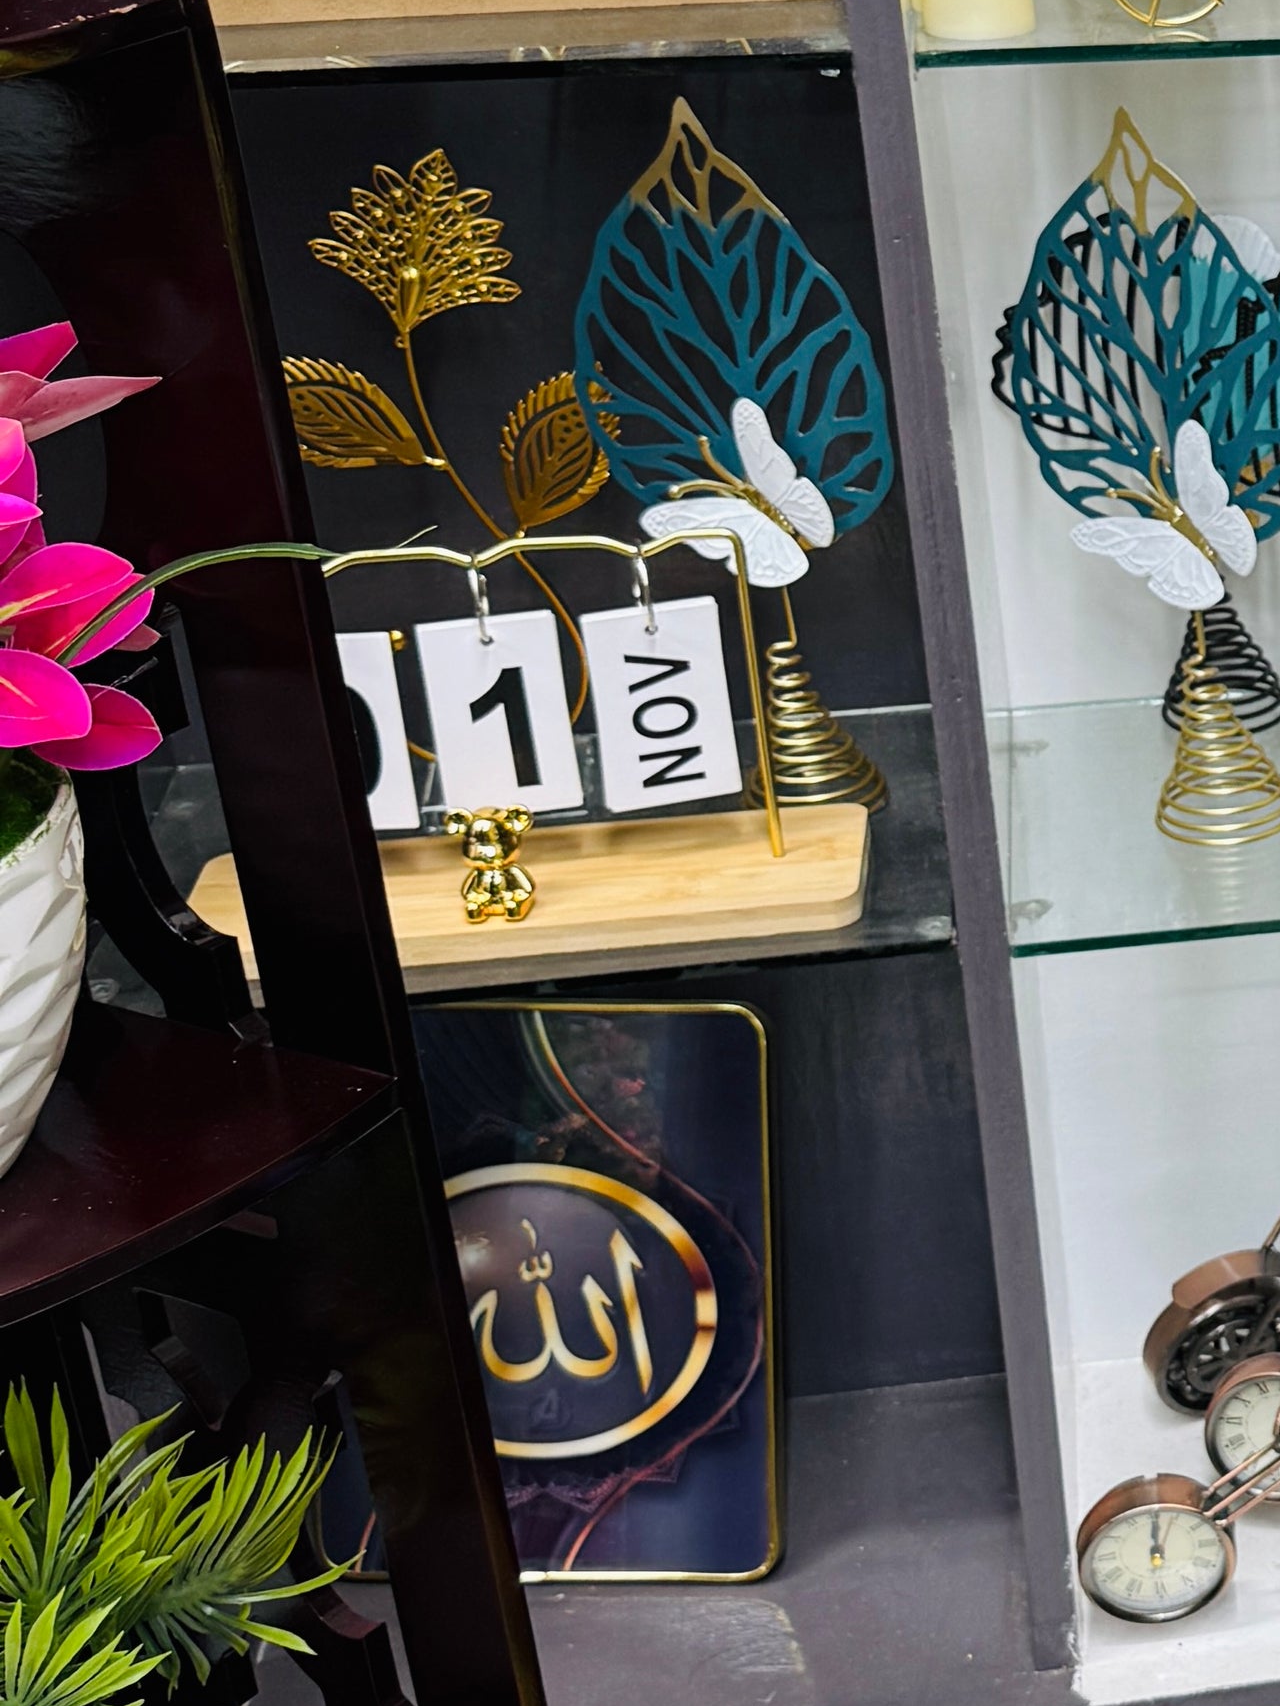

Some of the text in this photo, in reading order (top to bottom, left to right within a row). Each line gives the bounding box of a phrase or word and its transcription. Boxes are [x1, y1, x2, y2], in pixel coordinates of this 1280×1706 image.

[469, 666, 543, 788] 1
[623, 654, 707, 789] NOV
[470, 1218, 653, 1396] الله
